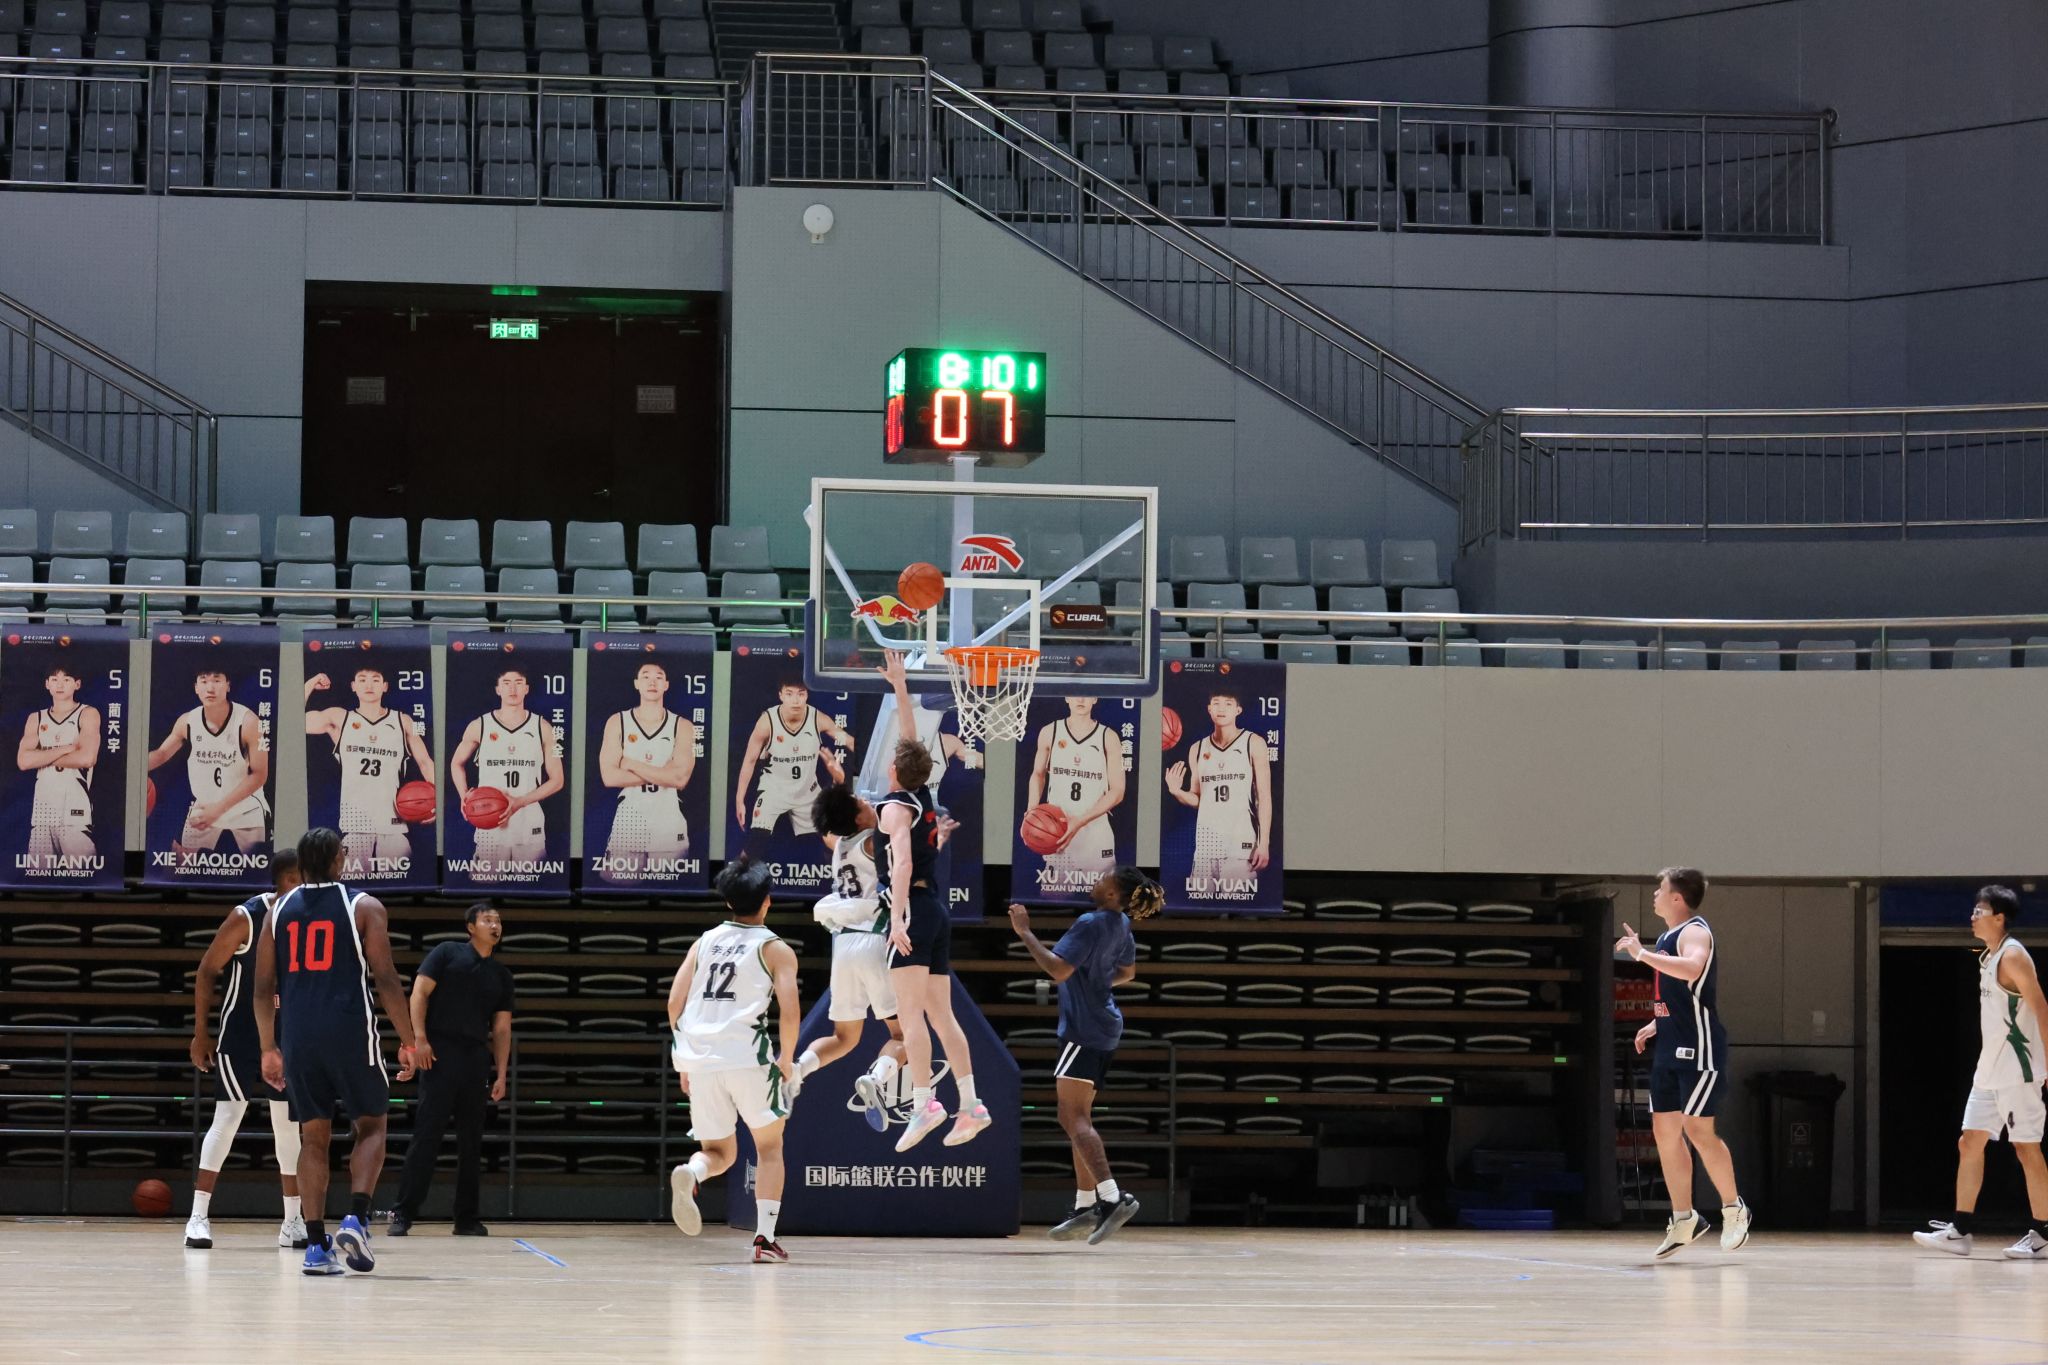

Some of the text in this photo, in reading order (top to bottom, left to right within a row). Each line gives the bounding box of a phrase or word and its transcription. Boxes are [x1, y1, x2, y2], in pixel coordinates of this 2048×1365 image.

[934, 389, 1013, 446] 07
[961, 556, 998, 571] ANTA
[1066, 613, 1104, 622] CUBAL
[109, 669, 122, 689] 5
[259, 668, 272, 688] 6
[398, 670, 424, 690] 23
[543, 675, 565, 694] 10
[684, 674, 706, 694] 15
[1258, 697, 1280, 716] 19
[359, 758, 381, 777] 23
[791, 766, 802, 780] 9
[213, 767, 222, 788] 6
[504, 771, 520, 788] 10
[1070, 782, 1082, 802] 8
[1213, 785, 1230, 803] 19
[16, 853, 105, 870] LIN TIANYU
[152, 851, 269, 869] XIE XIAOLONG
[367, 856, 411, 872] TENG
[447, 859, 564, 874] WANG JUNQUAN
[592, 857, 700, 874] ZHOU JUNCHI
[25, 869, 94, 878] XIDIAN UNIVERSITY
[174, 867, 244, 876] XIDIAN UNIVERSITY
[339, 871, 408, 881] XIDIAN UNIVERSITY
[471, 873, 540, 882] XIDIAN UNIVERSITY
[611, 872, 680, 881] XIDIAN UNIVERSITY
[786, 863, 835, 879] TIANS
[1035, 869, 1105, 885] XU XINB
[780, 878, 821, 886] UNIVERSITY
[1040, 884, 1066, 892] XIDIAN
[1185, 877, 1258, 893] LIU YUAN
[1188, 892, 1255, 901] XIDIAN UNIVERSITY
[286, 920, 335, 972] 10
[703, 961, 737, 1001] 12
[805, 1165, 987, 1188] 国际篮联合作伙伴
